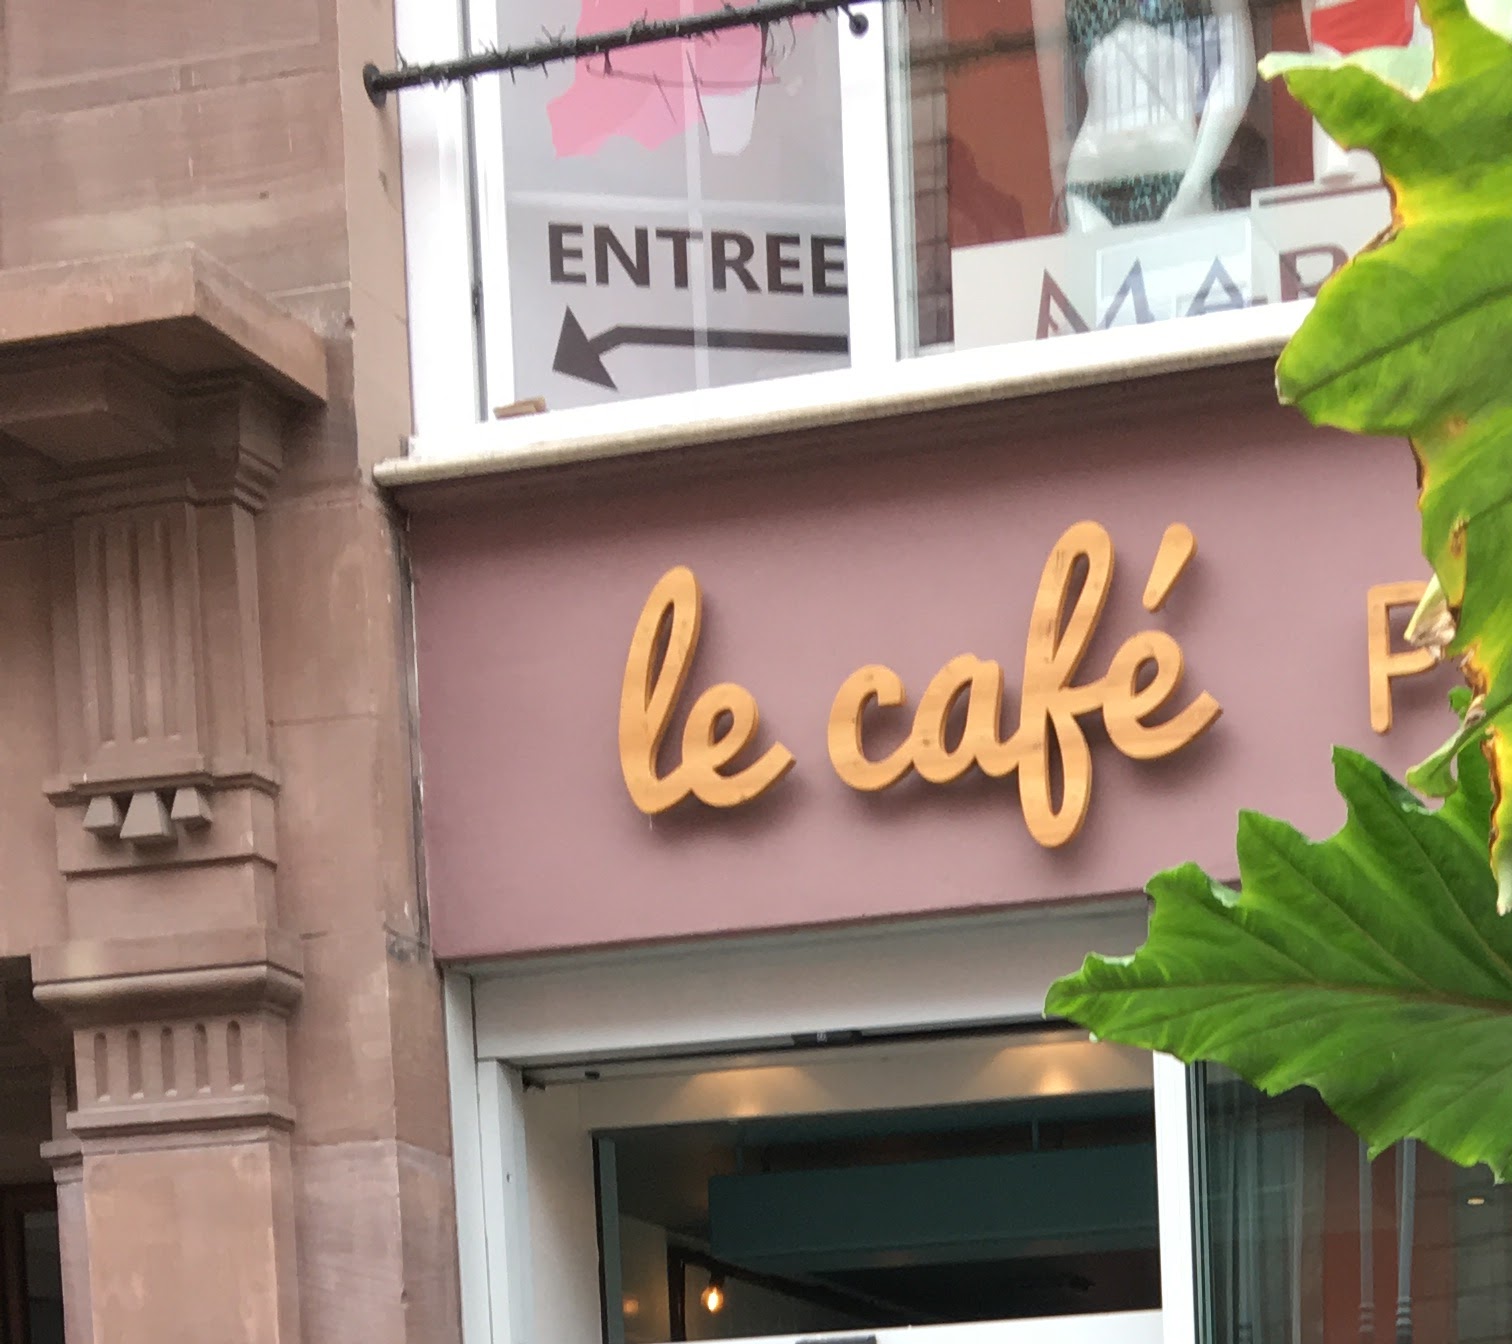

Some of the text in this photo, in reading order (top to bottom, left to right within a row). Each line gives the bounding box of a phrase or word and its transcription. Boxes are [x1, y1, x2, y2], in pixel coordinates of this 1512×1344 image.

[548, 222, 847, 297] ENTREE
[619, 566, 796, 814] le
[827, 520, 1222, 848] café
